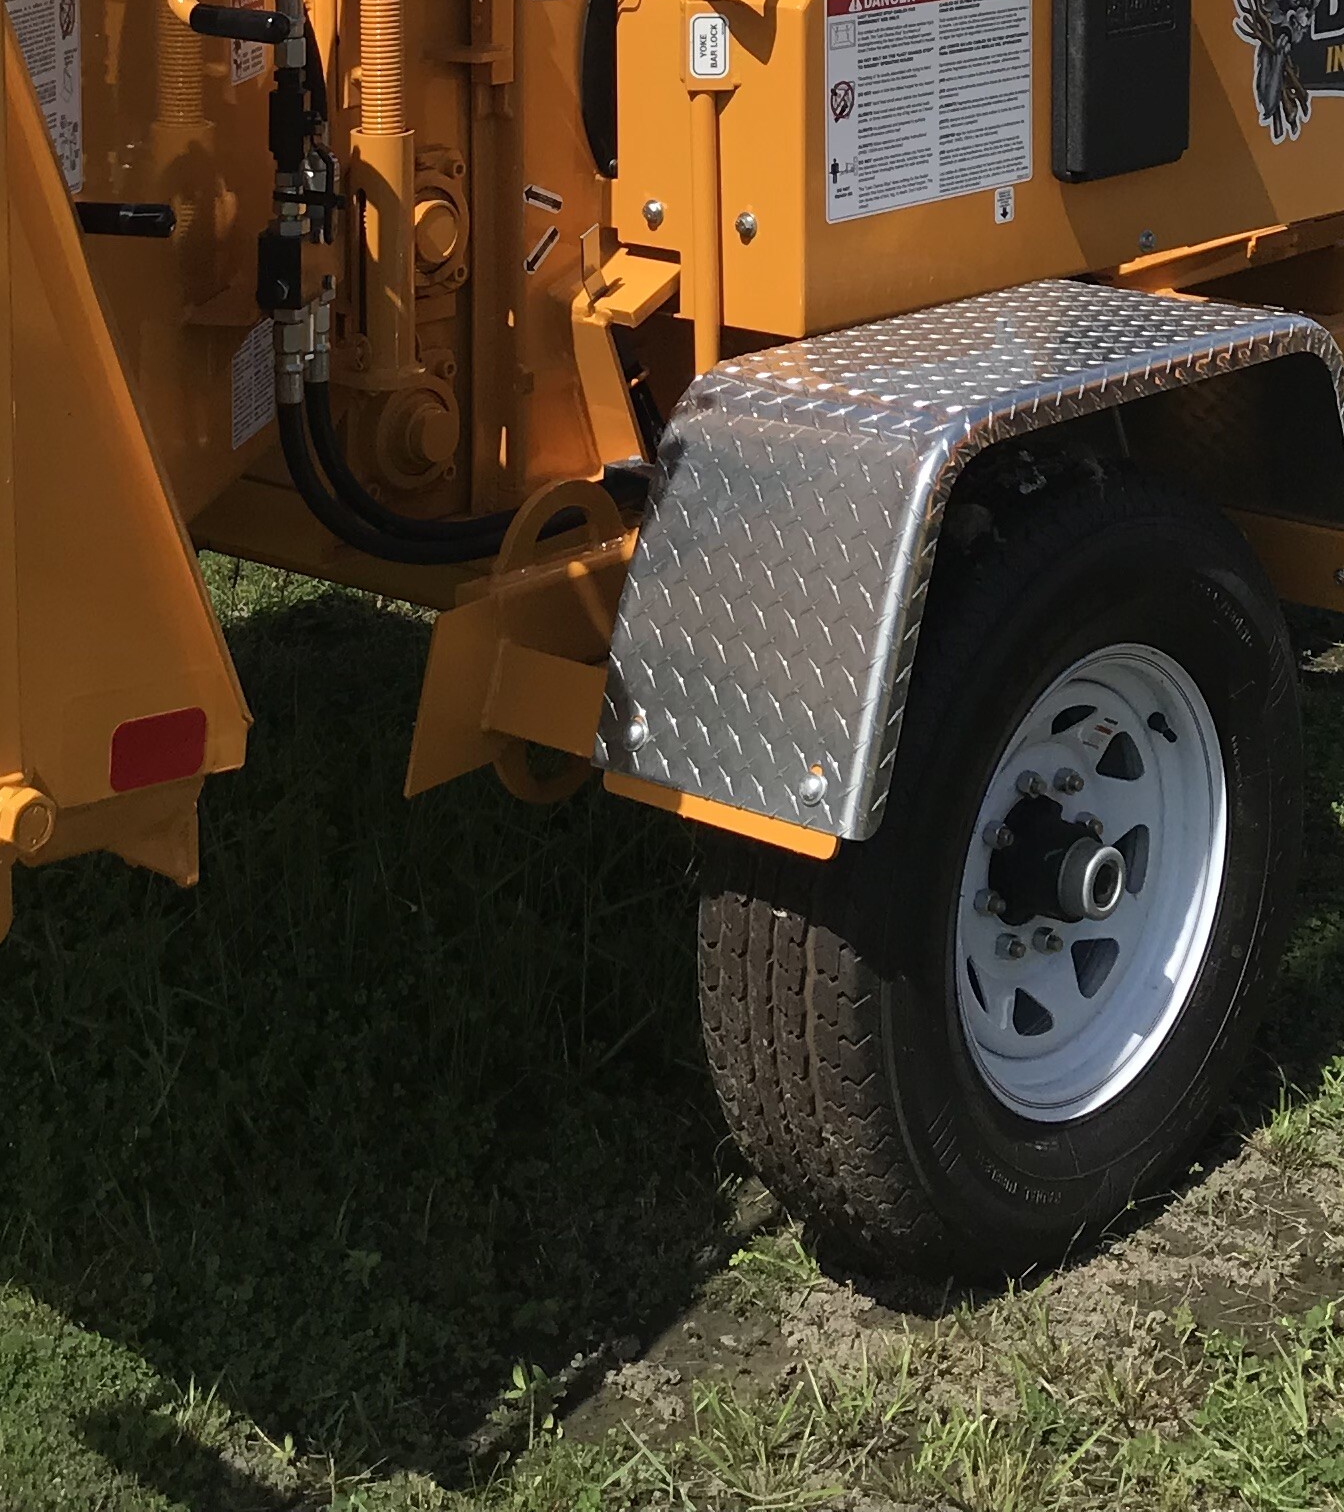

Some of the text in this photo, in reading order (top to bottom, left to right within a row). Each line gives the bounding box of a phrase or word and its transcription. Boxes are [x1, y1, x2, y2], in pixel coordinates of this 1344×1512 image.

[700, 34, 708, 58] YOKE
[710, 24, 718, 69] BAR LOCK
